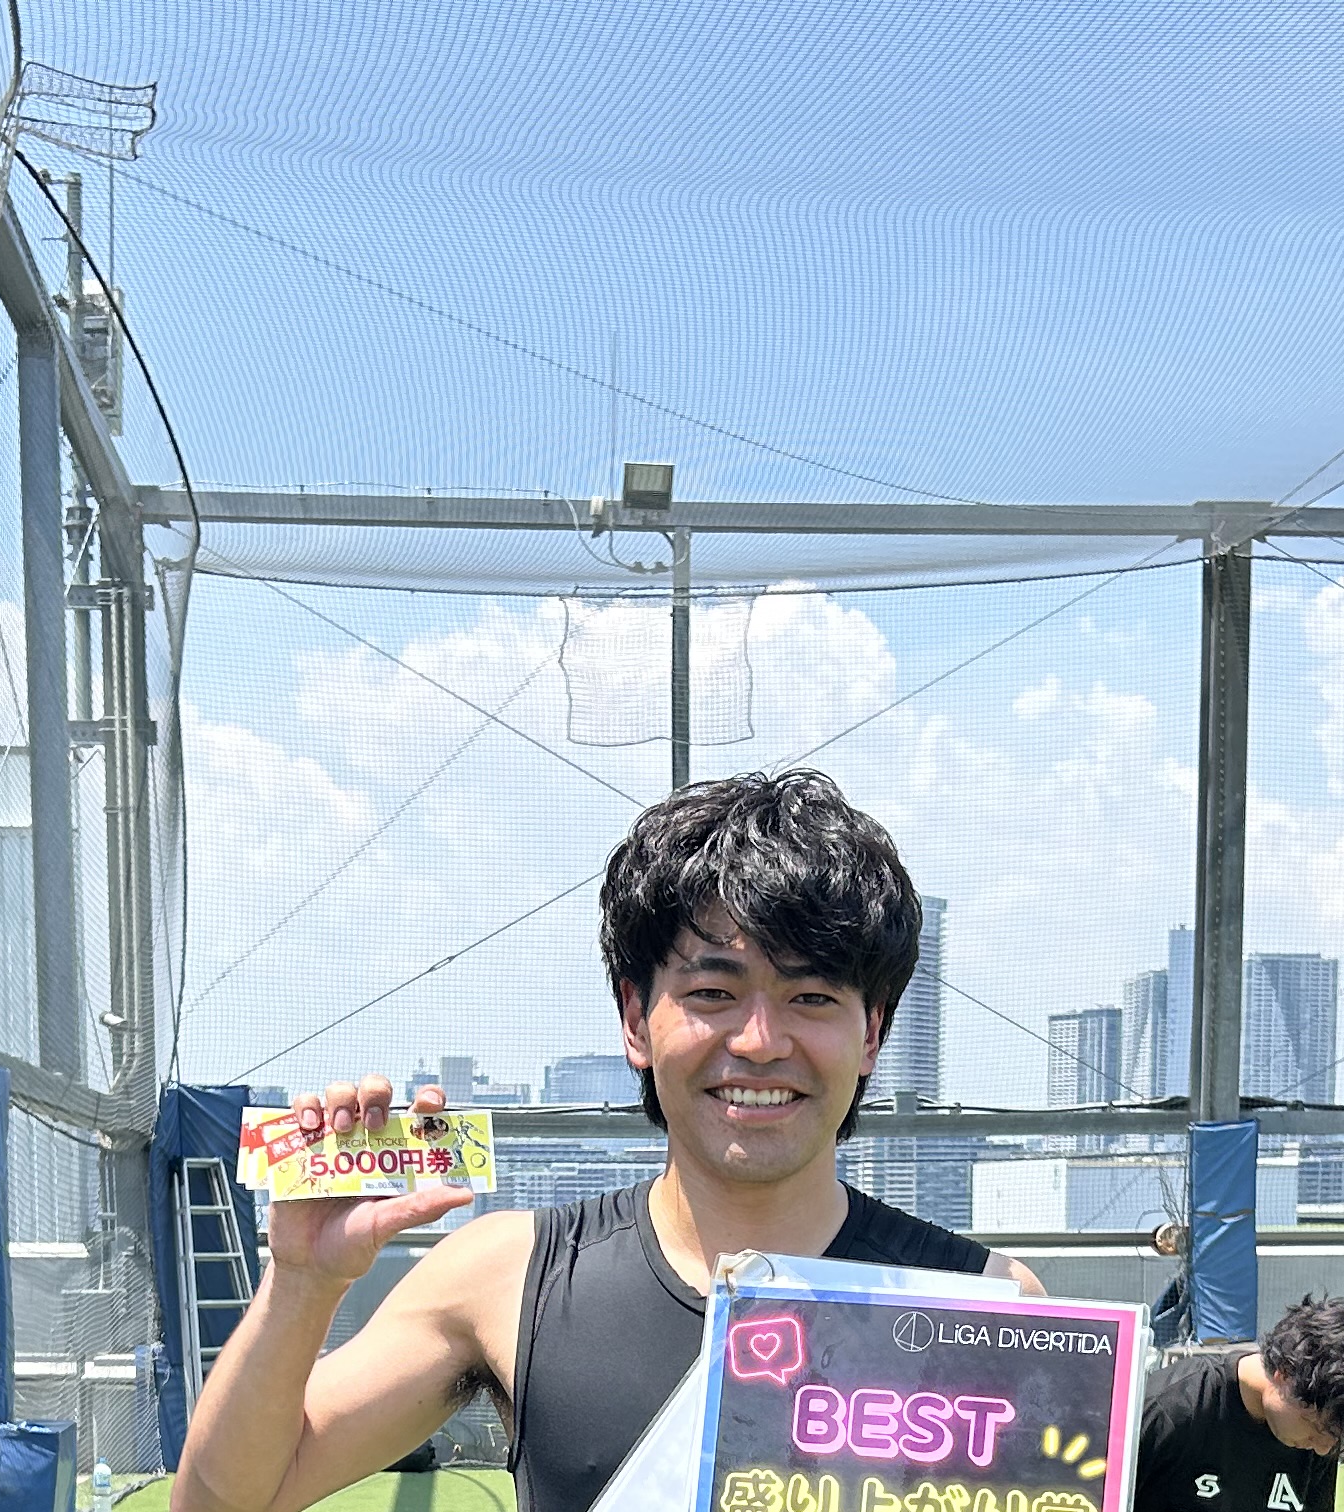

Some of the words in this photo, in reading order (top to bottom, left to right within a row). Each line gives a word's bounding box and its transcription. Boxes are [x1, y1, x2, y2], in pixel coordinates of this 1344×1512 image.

[375, 1137, 409, 1147] TICKET
[309, 1147, 454, 1179] 5,000円券
[792, 1383, 1016, 1466] BEST
